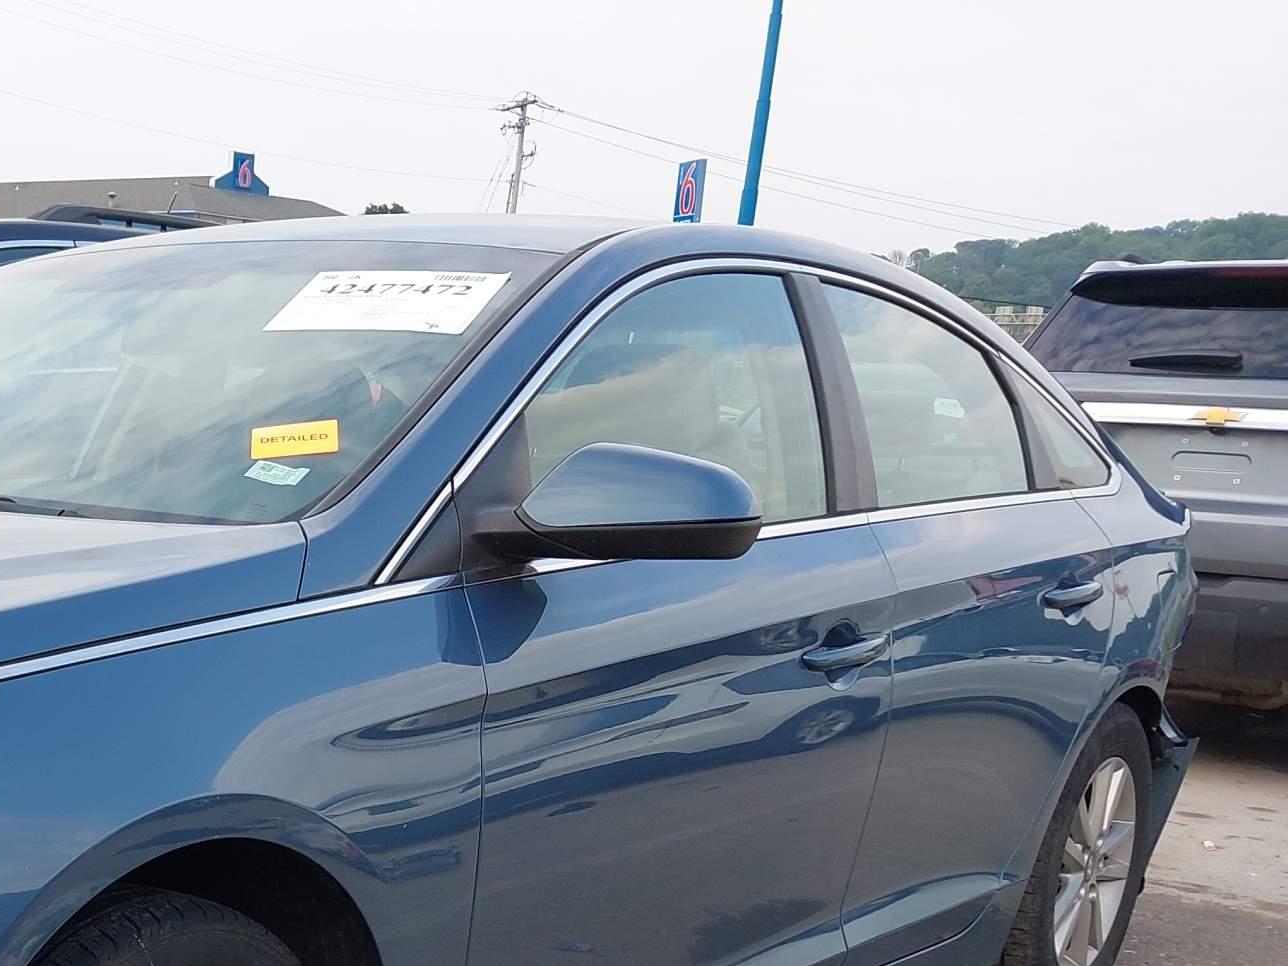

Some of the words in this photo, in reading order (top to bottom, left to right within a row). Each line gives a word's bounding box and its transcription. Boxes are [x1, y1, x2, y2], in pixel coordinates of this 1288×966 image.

[239, 160, 252, 188] 6
[679, 162, 697, 216] 6
[320, 283, 473, 296] 42477472
[260, 433, 329, 444] DETAILED
